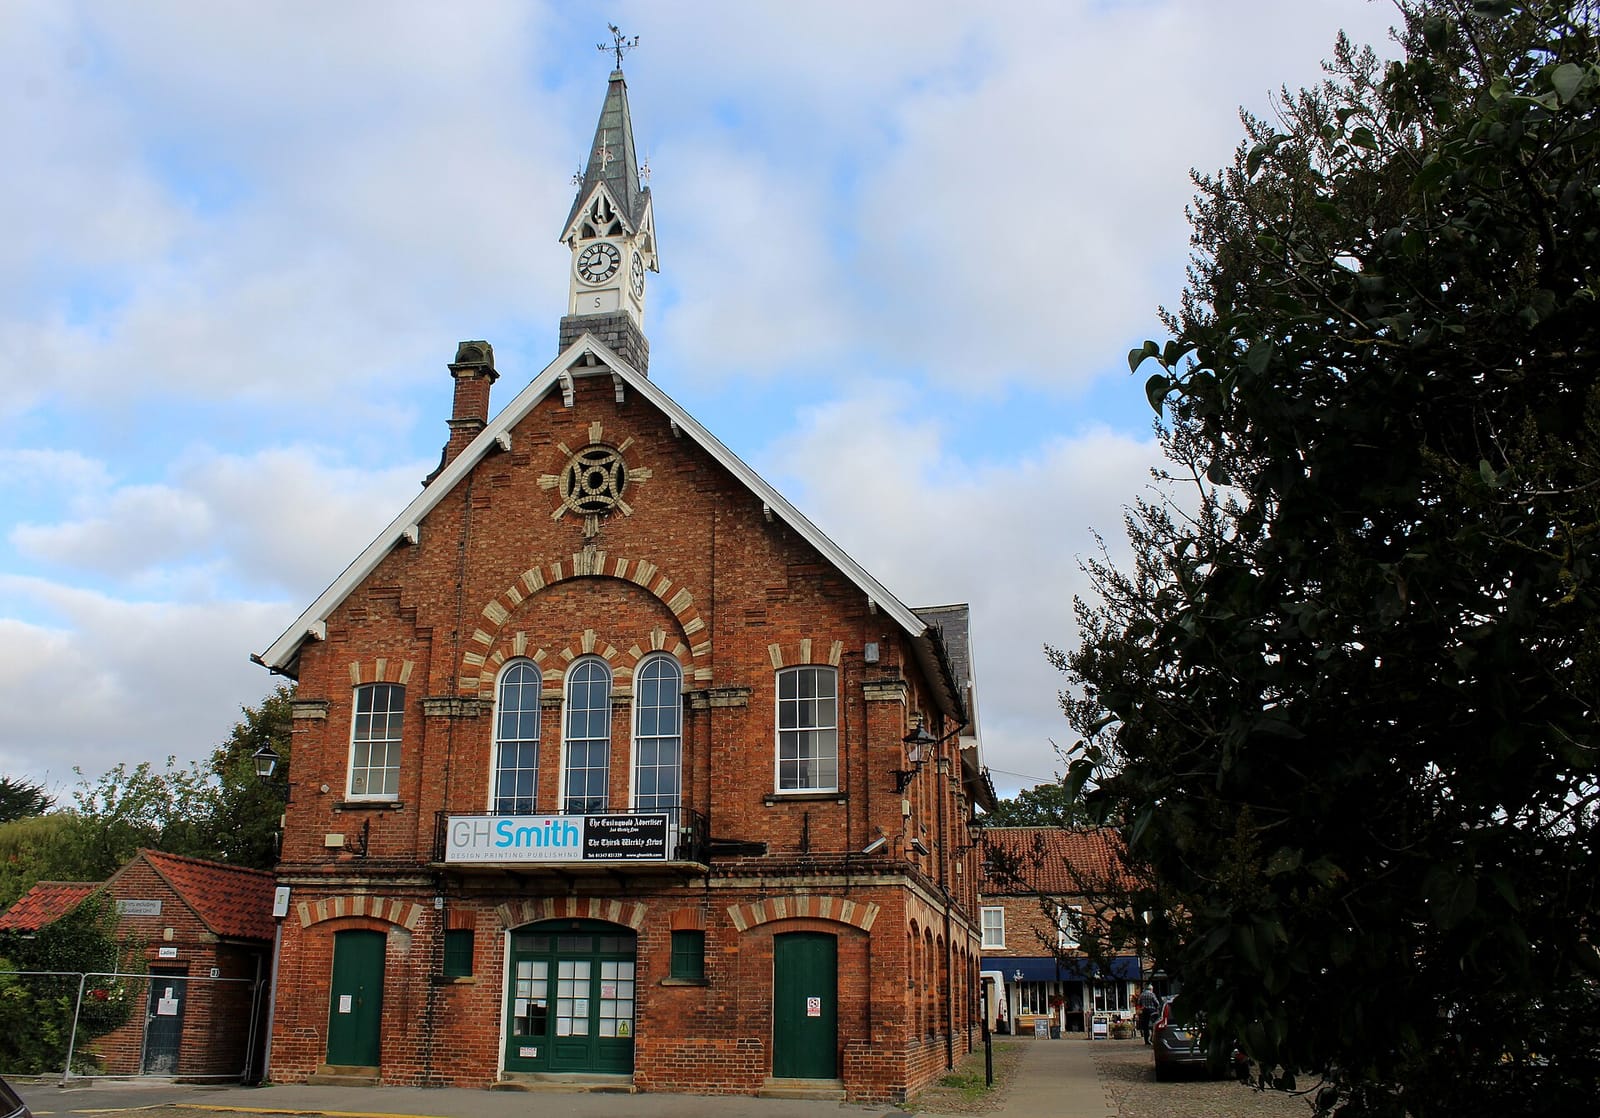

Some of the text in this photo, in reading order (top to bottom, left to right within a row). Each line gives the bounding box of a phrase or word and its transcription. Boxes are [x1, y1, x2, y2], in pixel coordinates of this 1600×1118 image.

[594, 297, 601, 308] S
[589, 818, 600, 828] The
[634, 818, 663, 827] Advertiser
[495, 820, 579, 848] Smith
[588, 838, 663, 847] The Thirsk Weekly News
